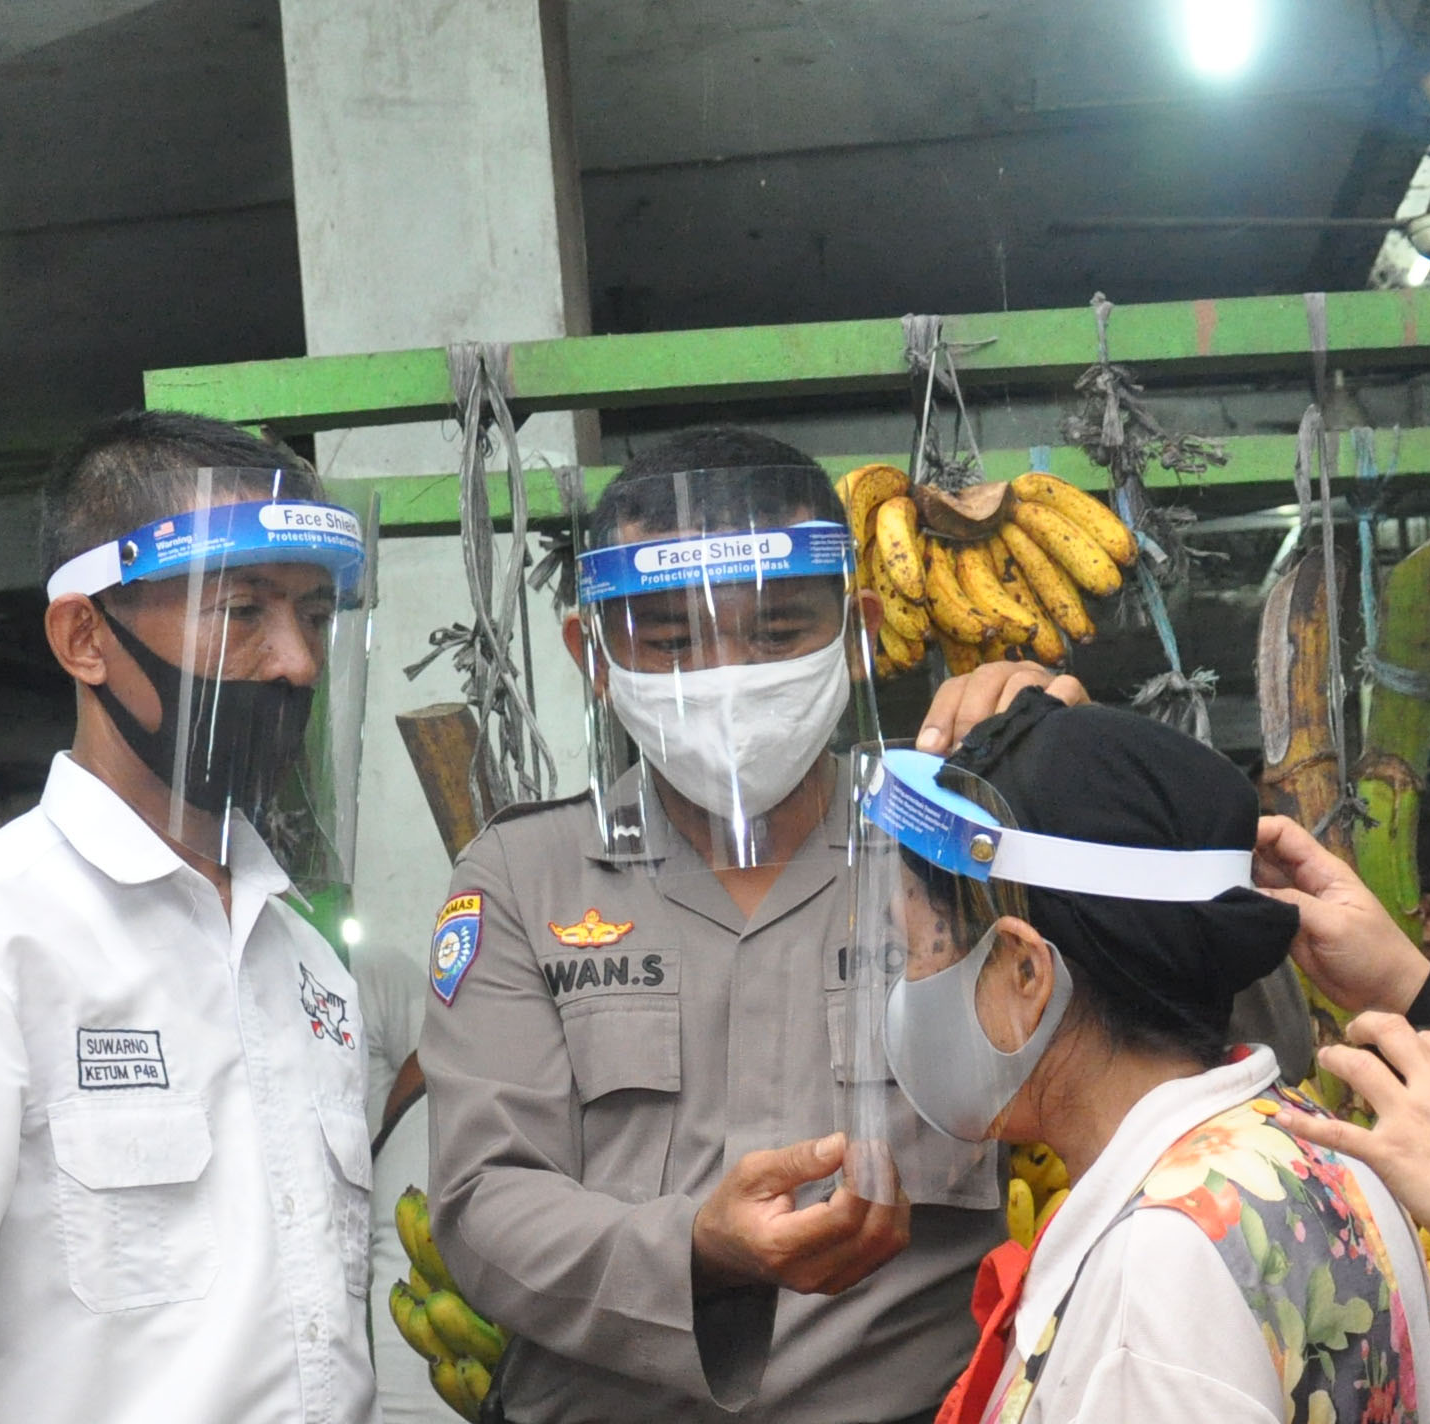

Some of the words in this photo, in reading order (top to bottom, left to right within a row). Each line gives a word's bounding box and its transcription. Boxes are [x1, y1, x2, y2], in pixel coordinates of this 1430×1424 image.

[283, 509, 322, 527] Face
[267, 530, 322, 542] Protective
[657, 548, 701, 566] Face
[710, 538, 771, 559] Shied
[640, 567, 701, 585] Protective
[704, 563, 757, 577] solation
[760, 559, 791, 571] Mask
[544, 953, 665, 997] WAN.S
[86, 1039, 149, 1055] SUWARNO
[85, 1065, 130, 1081] KETUM
[134, 1064, 159, 1080] P4B
